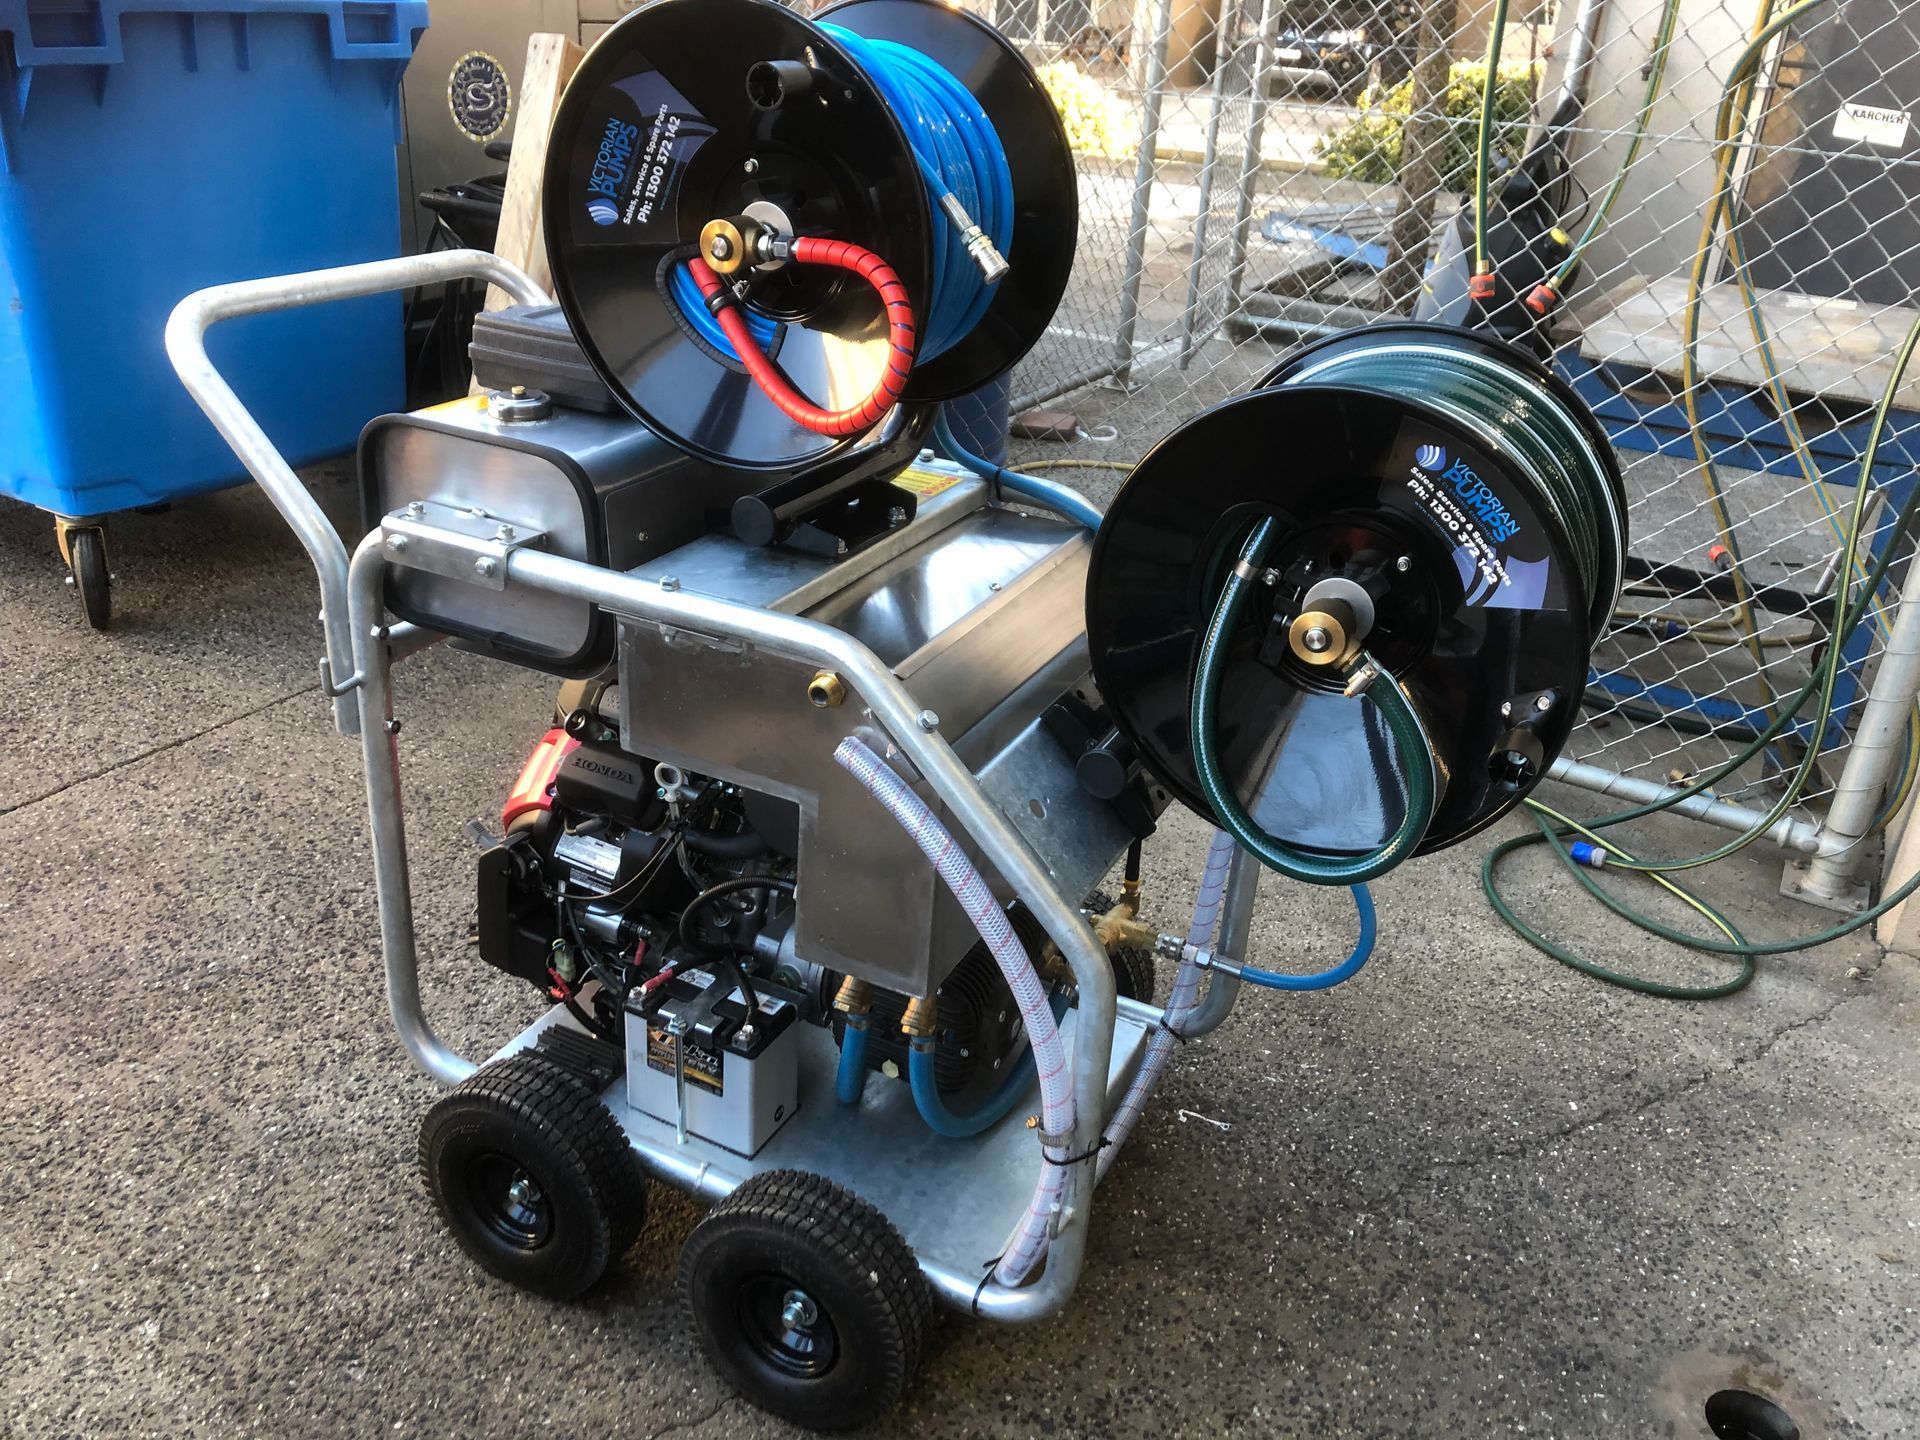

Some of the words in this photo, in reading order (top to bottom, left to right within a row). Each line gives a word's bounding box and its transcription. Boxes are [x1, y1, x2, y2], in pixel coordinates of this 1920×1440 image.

[587, 117, 621, 193] VICTORIAN
[600, 123, 638, 198] PUMPS
[623, 198, 638, 224] Sales,
[632, 163, 649, 196] Service
[646, 126, 660, 153] Spare
[655, 104, 668, 127] Parts
[637, 200, 653, 223] Ph:
[645, 165, 664, 198] 1300
[657, 140, 673, 164] 372
[665, 115, 681, 139] 142
[1407, 479, 1430, 500] Ph:
[1429, 498, 1460, 531] 1300
[1458, 531, 1480, 559] 372
[1477, 558, 1498, 585] 142
[1410, 466, 1435, 491] Sales,
[1436, 490, 1466, 522] Service
[1472, 531, 1494, 559] Spare
[1492, 558, 1512, 587] Parts
[1441, 468, 1512, 543] PUMPS
[1453, 457, 1521, 535] VICTORIAN
[571, 757, 634, 784] HONDA
